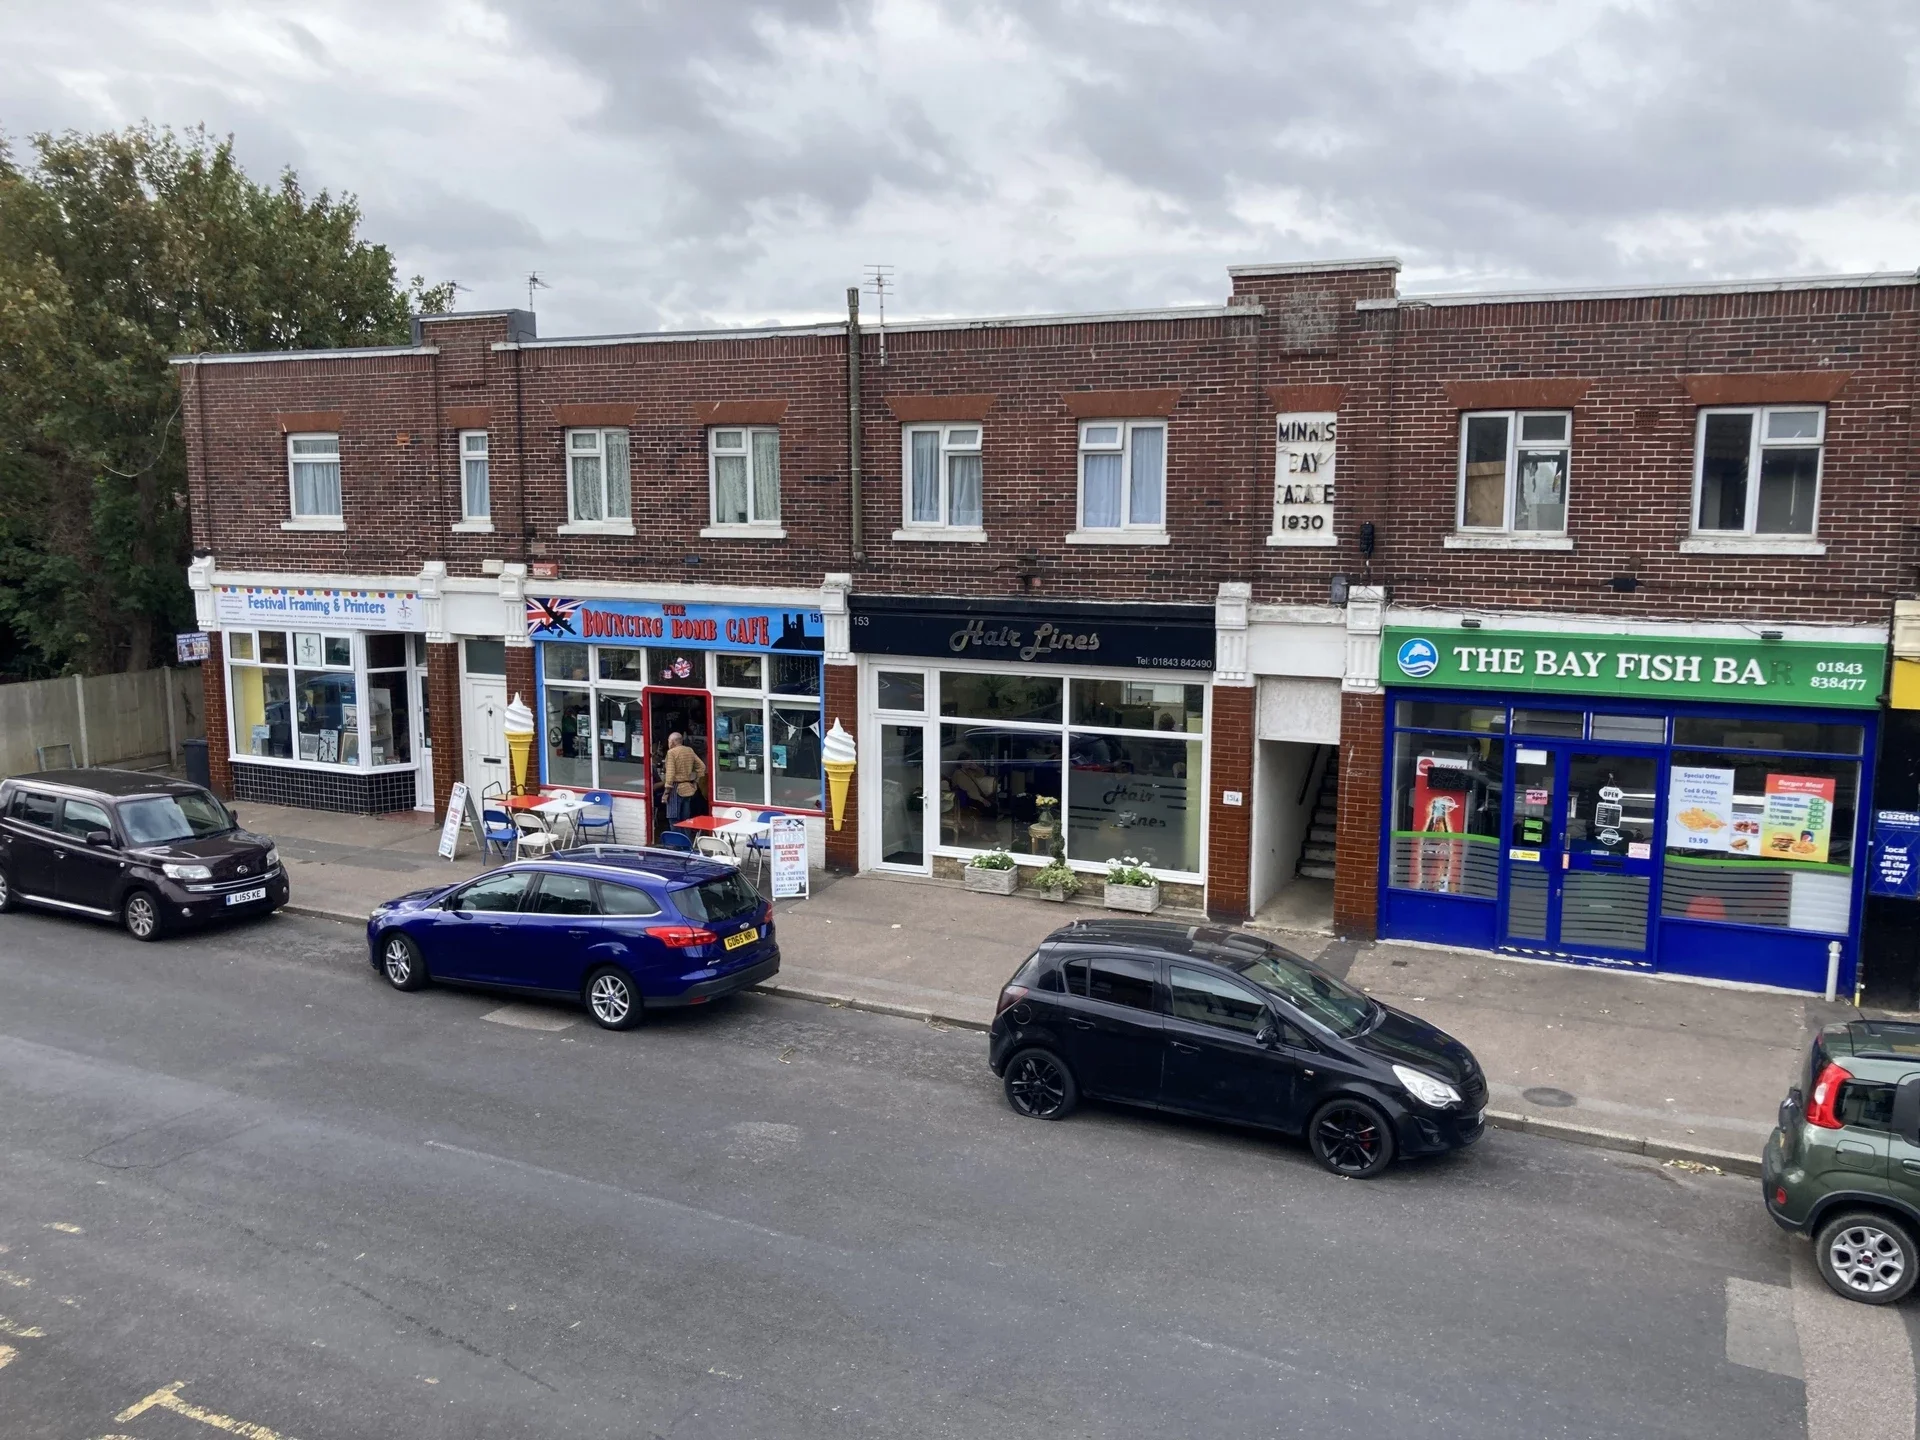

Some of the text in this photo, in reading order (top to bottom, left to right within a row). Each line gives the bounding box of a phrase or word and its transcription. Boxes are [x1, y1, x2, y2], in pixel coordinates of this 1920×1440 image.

[1276, 484, 1334, 505] ARAE
[1281, 514, 1324, 530] 1930
[248, 595, 286, 610] Festival
[289, 597, 330, 615] Framing
[334, 598, 341, 612] &
[344, 598, 386, 614] Printers
[662, 603, 687, 616] THE
[809, 613, 823, 624] 151
[853, 616, 870, 626] 153
[671, 618, 717, 641] BOMB
[726, 616, 770, 646] CAFE
[949, 620, 1100, 661] Hair Lines
[1136, 656, 1212, 668] Tel: 01843 842490
[1453, 646, 1525, 674] THE
[1534, 649, 1607, 677] BAY
[1615, 652, 1703, 683] FISH
[1816, 661, 1863, 675] 01843
[1810, 676, 1867, 691] 838477
[1879, 811, 1920, 822] Gazette
[1885, 845, 1907, 854] local
[1893, 862, 1911, 870] day
[1881, 869, 1908, 877] every
[1885, 876, 1903, 884] day
[251, 889, 261, 899] KE
[727, 935, 744, 948] GD65
